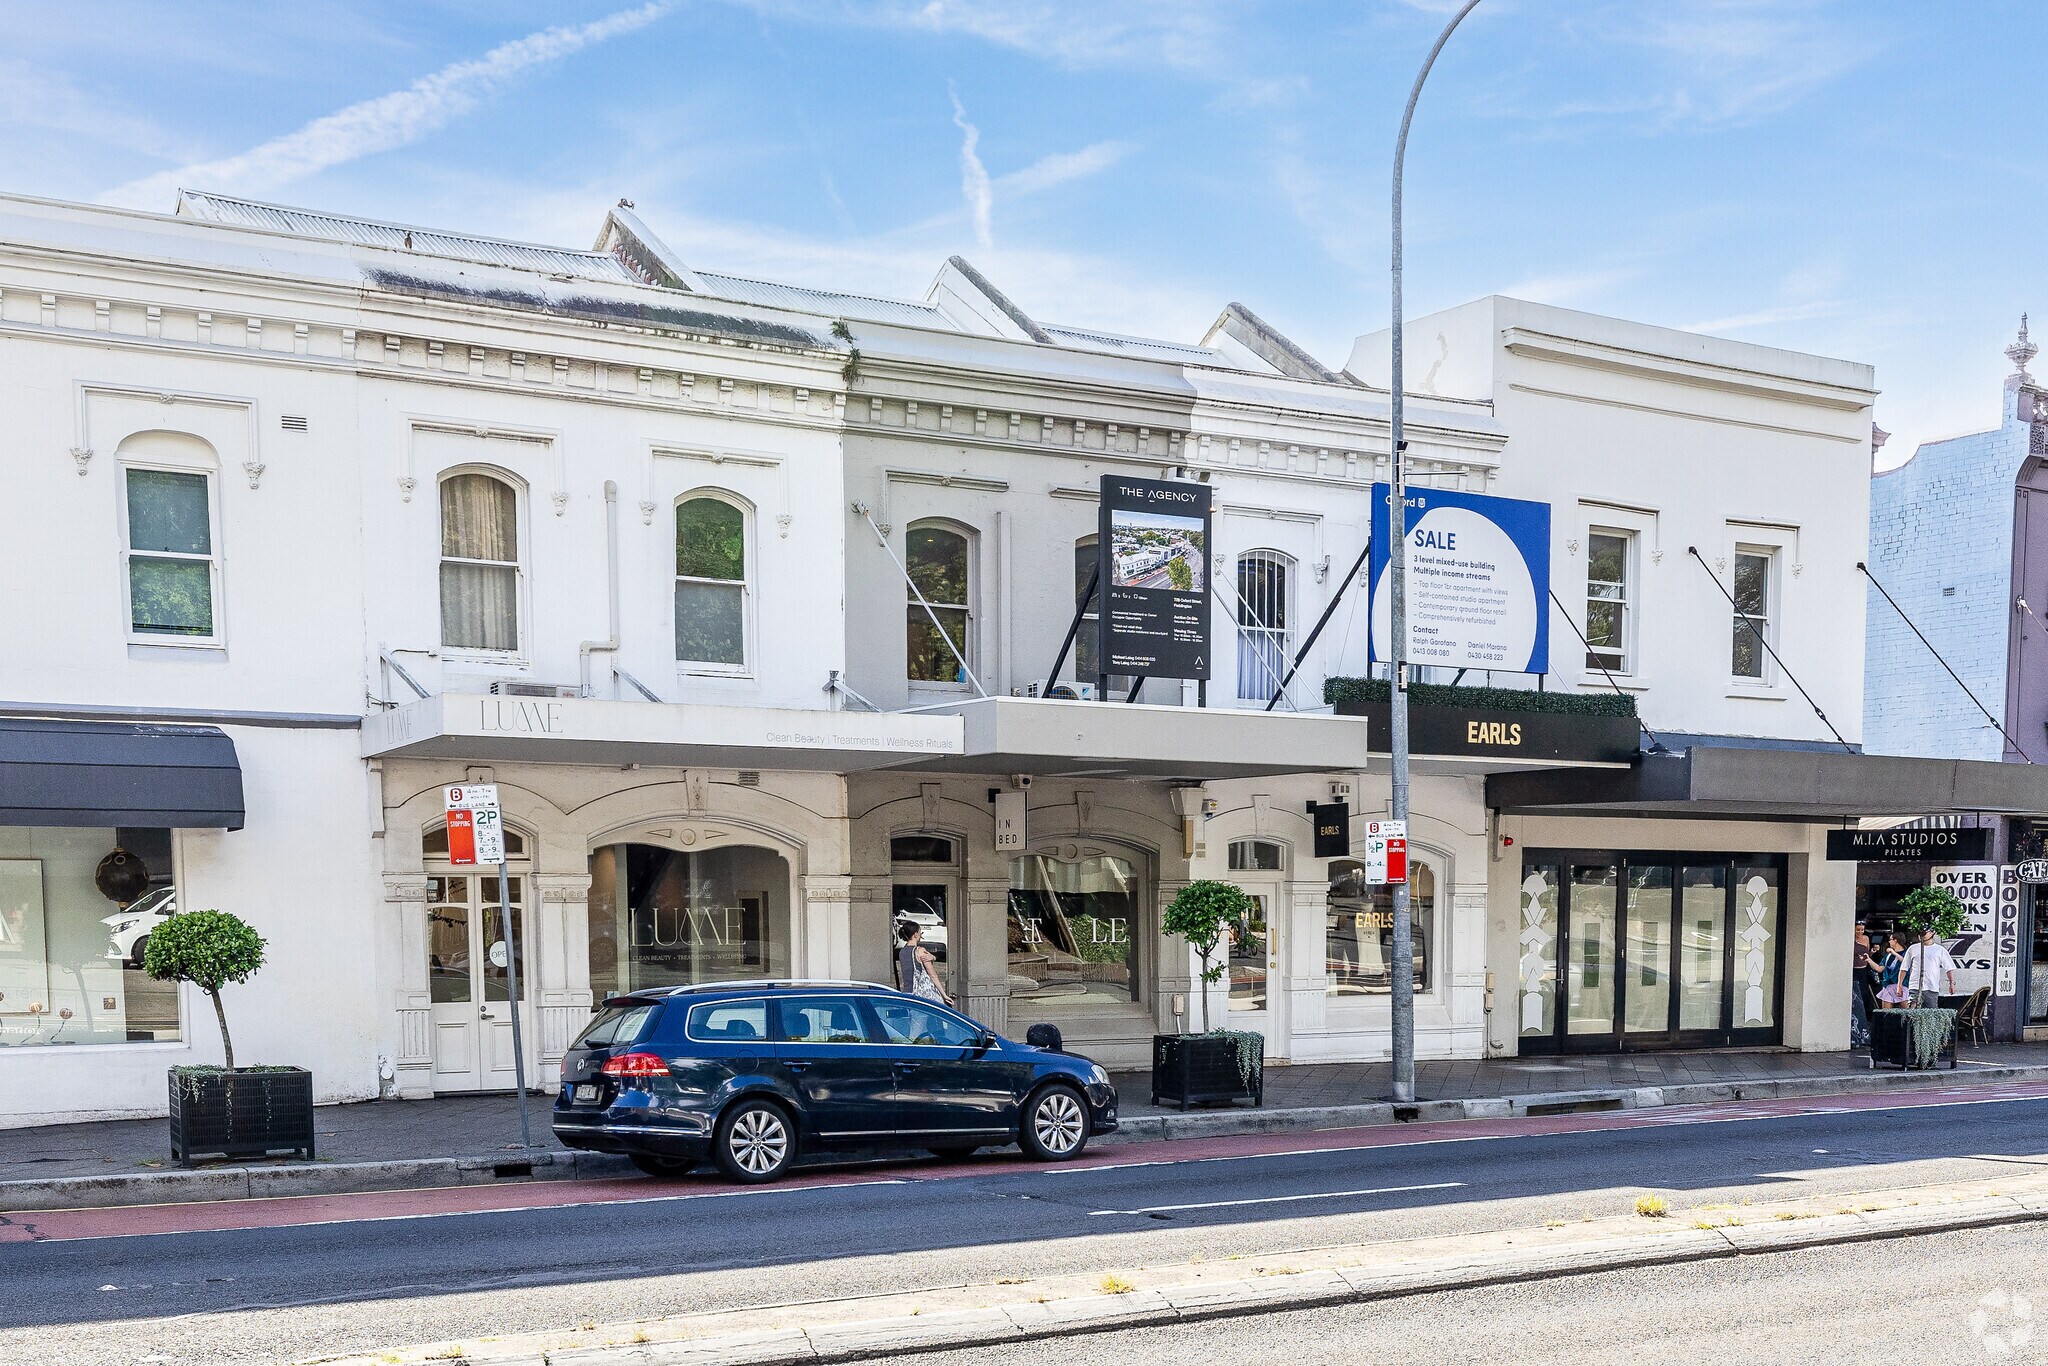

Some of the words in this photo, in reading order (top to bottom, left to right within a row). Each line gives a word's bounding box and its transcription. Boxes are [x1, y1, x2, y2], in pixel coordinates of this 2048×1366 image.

[1119, 486, 1144, 498] THE
[1147, 489, 1197, 503] AGENCY
[1414, 528, 1456, 551] SALE
[1413, 554, 1418, 563] 3
[1419, 555, 1435, 564] level
[1436, 557, 1469, 568] mixed-use
[1470, 561, 1496, 572] building
[1413, 566, 1441, 577] Multiple
[1441, 569, 1465, 579] income
[1466, 572, 1491, 581] streams
[1419, 580, 1429, 589] Top
[1453, 584, 1481, 593] apartment
[1494, 588, 1509, 596] views
[1418, 590, 1459, 601] Self-contained
[1478, 598, 1506, 606] apartment
[1418, 602, 1458, 612] Contemporary
[1459, 606, 1479, 614] ground
[1479, 607, 1492, 615] floor
[1418, 612, 1465, 624] Comprehensively
[1466, 617, 1496, 626] refurbished
[1412, 625, 1439, 635] Contact
[1412, 637, 1429, 645] Ralph
[1467, 641, 1485, 650] Daniel
[480, 700, 563, 734] LUME
[766, 732, 792, 743] Clean
[794, 733, 825, 746] Beauty
[832, 735, 880, 746] Treatments
[886, 737, 924, 748] Wellness
[926, 738, 953, 749] Rituals
[1467, 720, 1522, 746] EARLS
[475, 810, 498, 825] 2P
[998, 819, 1011, 829] IN
[1320, 825, 1340, 836] EARLS
[998, 834, 1018, 845] BED
[1890, 832, 1958, 846] STUDIOS
[1884, 848, 1922, 856] PILATES
[2018, 861, 2048, 878] CAF
[1935, 872, 1988, 884] OVER
[2000, 869, 2018, 954] BOOKS
[630, 907, 747, 947] LUME
[1355, 912, 1394, 929] EARLS
[1942, 933, 1983, 957] 7
[491, 950, 507, 959] OPE
[1999, 980, 2013, 993] SOLD
